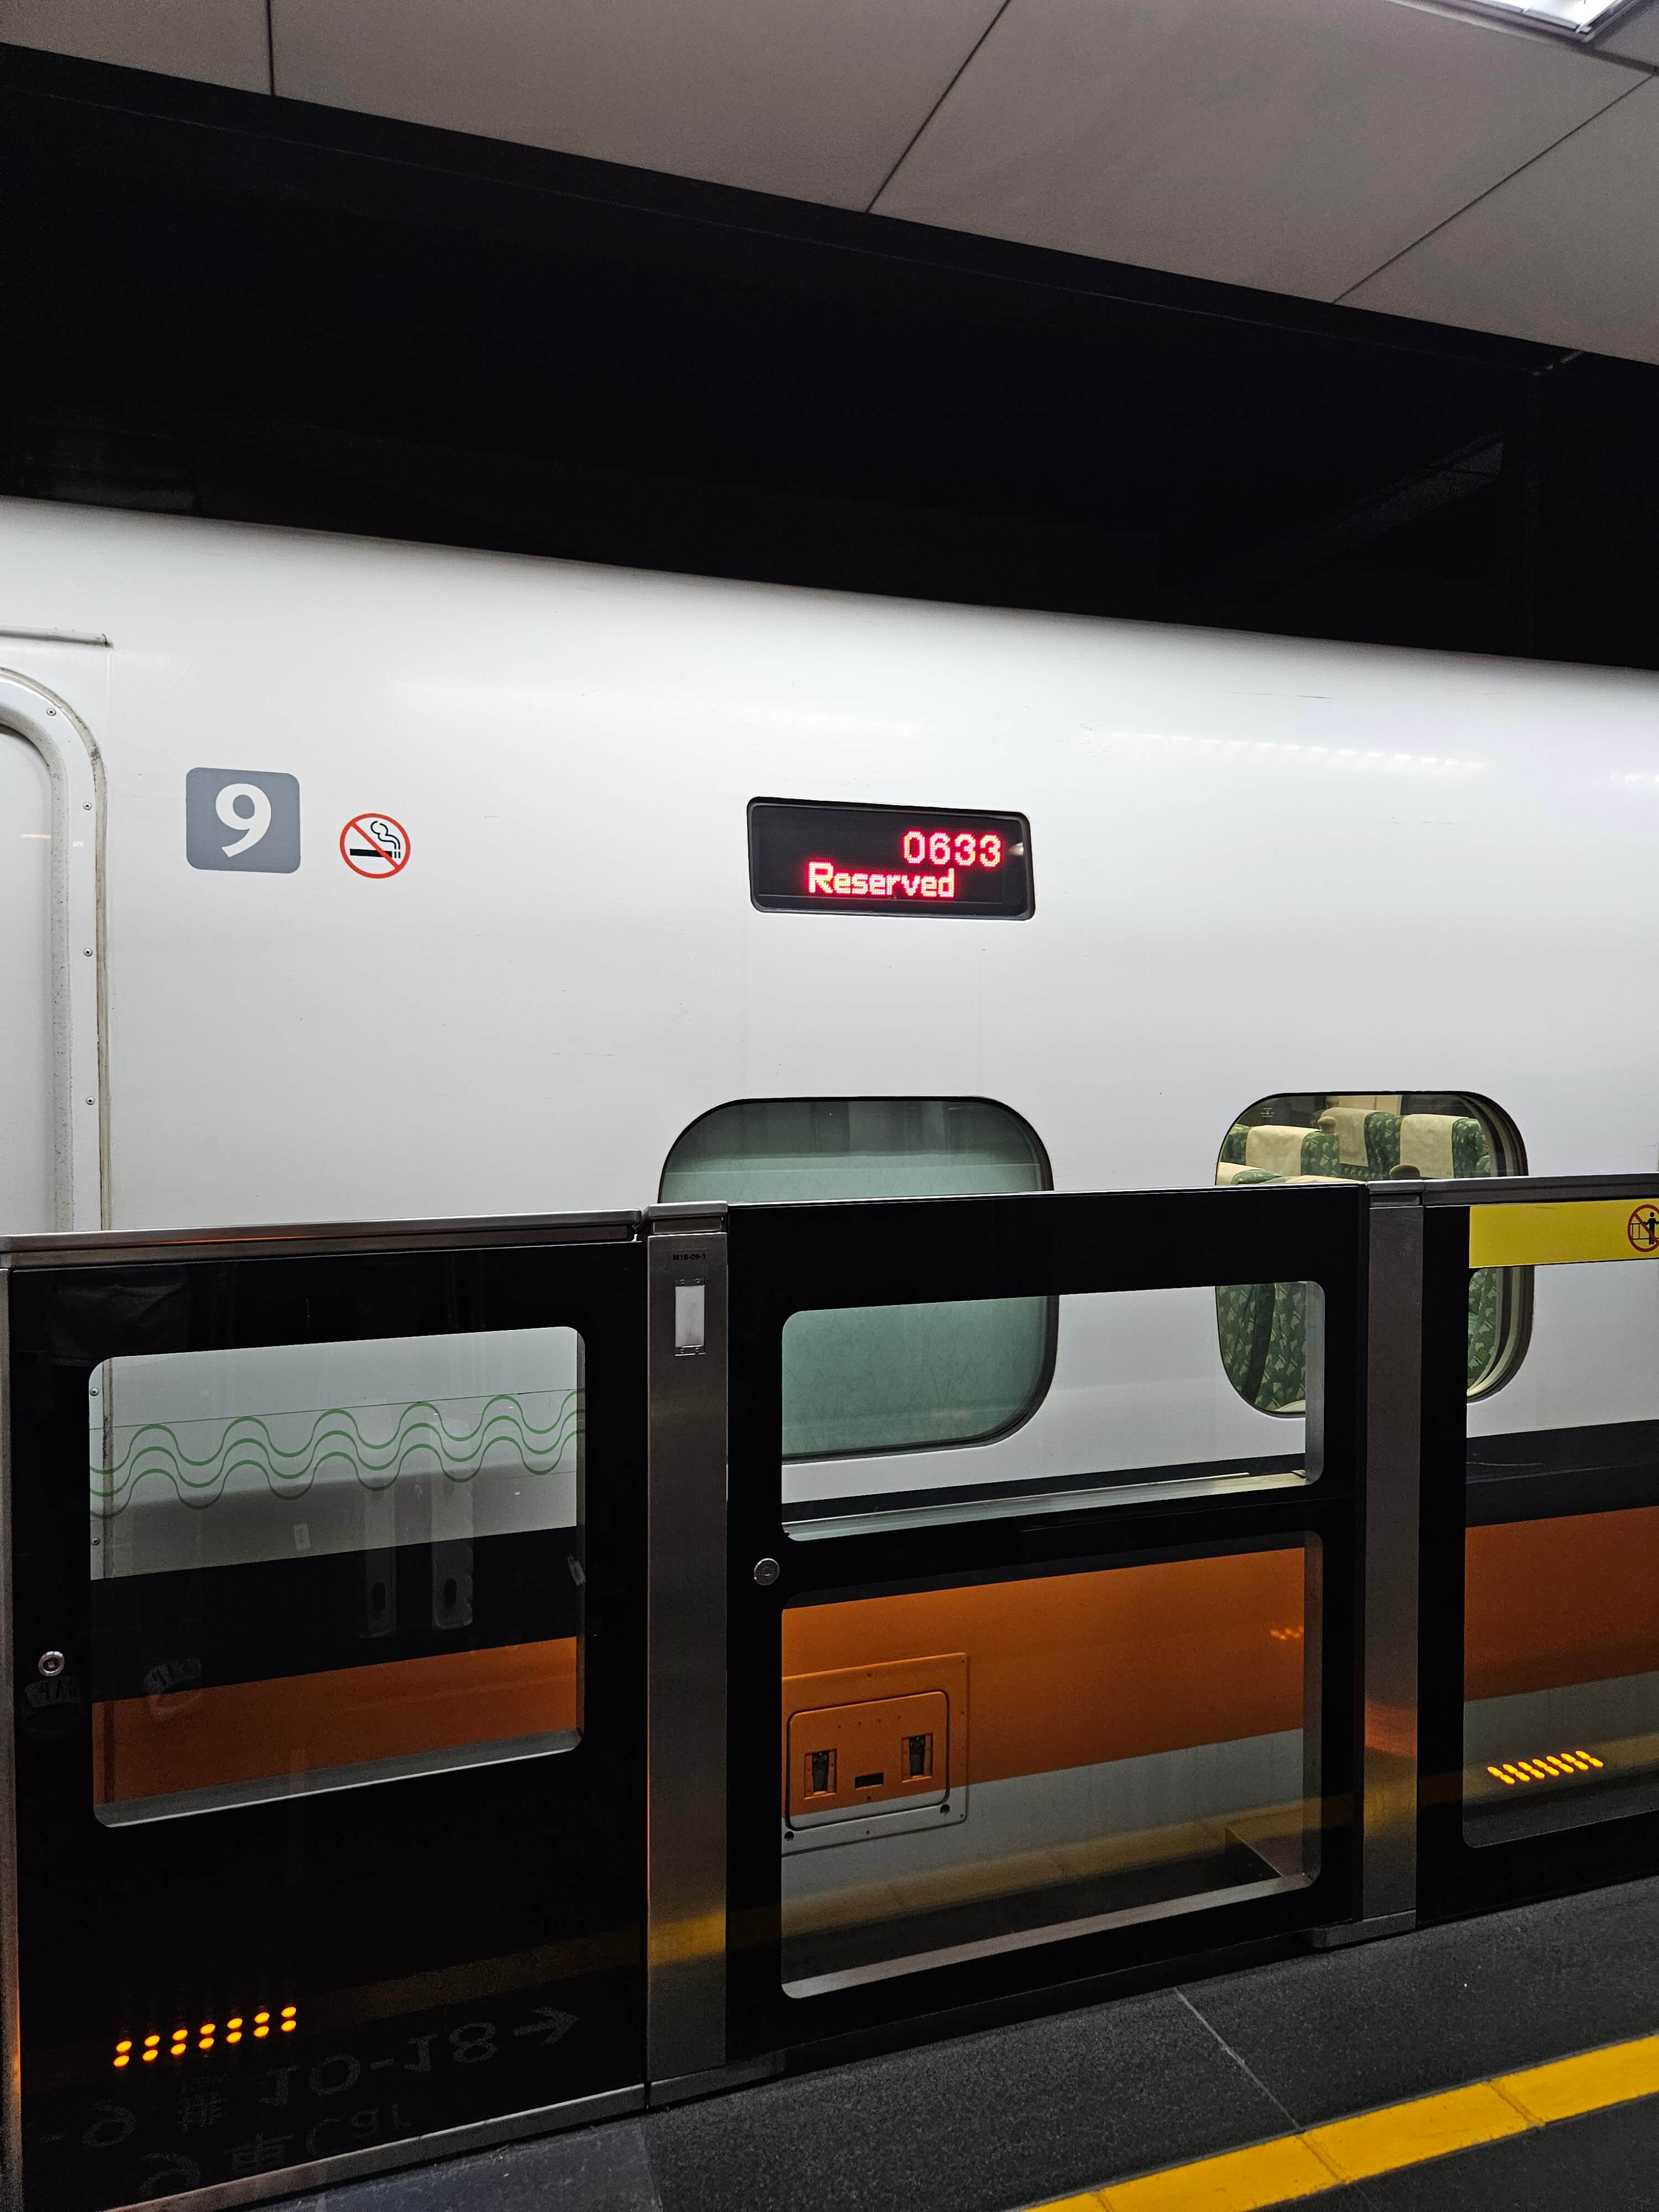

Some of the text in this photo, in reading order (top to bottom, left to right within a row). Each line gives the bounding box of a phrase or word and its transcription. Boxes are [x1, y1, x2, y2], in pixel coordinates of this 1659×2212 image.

[215, 783, 272, 858] 9
[902, 830, 1001, 867] 0633
[807, 861, 955, 898] Reserved
[672, 1253, 706, 1261] M1B-09-1
